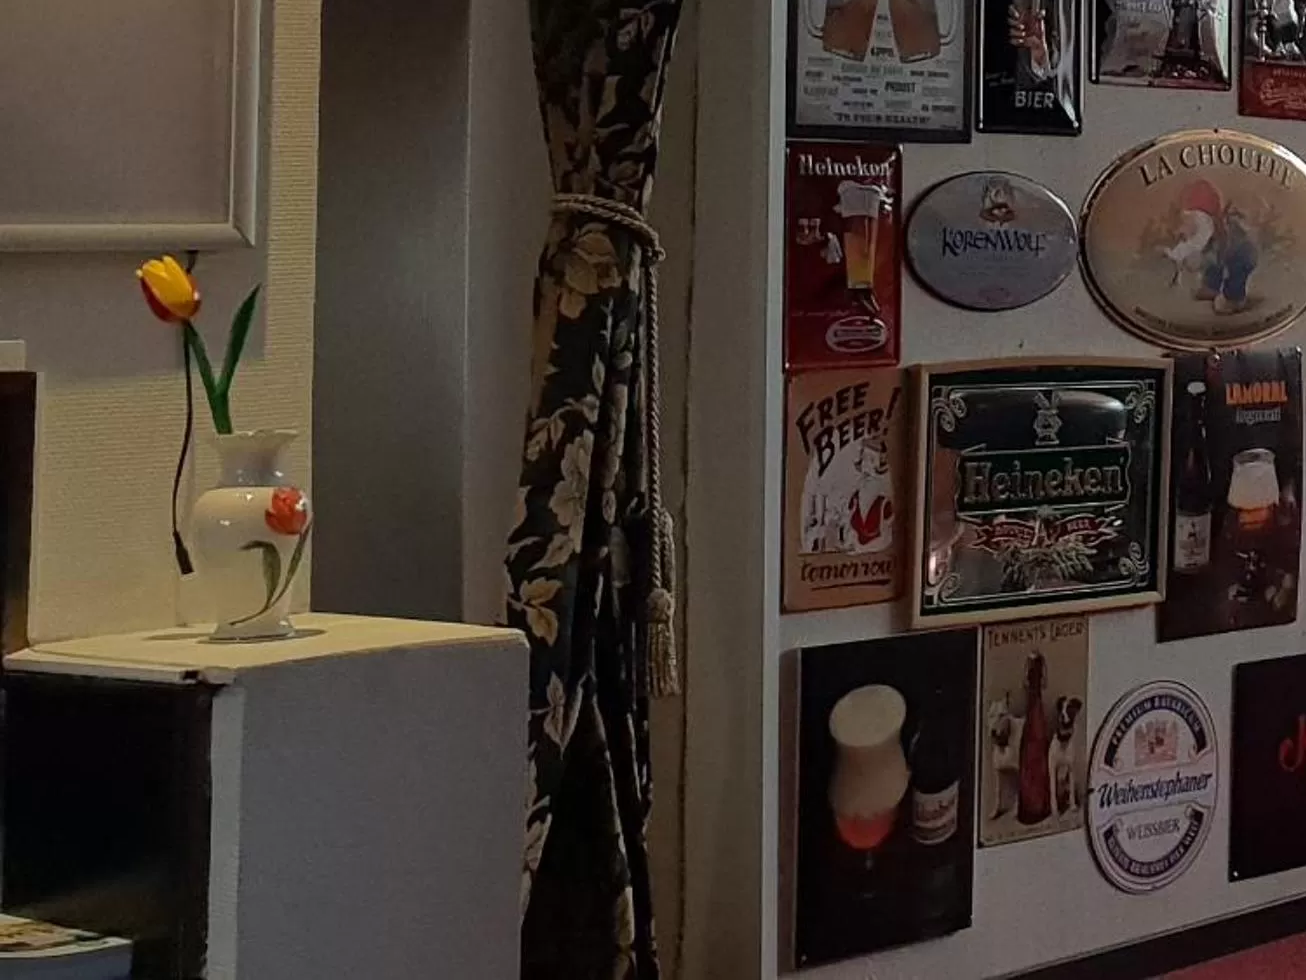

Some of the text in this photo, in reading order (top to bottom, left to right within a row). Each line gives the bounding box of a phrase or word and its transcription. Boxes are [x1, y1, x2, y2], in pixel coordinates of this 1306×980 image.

[1014, 91, 1055, 109] BIER
[1140, 144, 1298, 189] LA CHOUFFE
[796, 382, 870, 455] FREE
[963, 457, 1121, 504] Heineken
